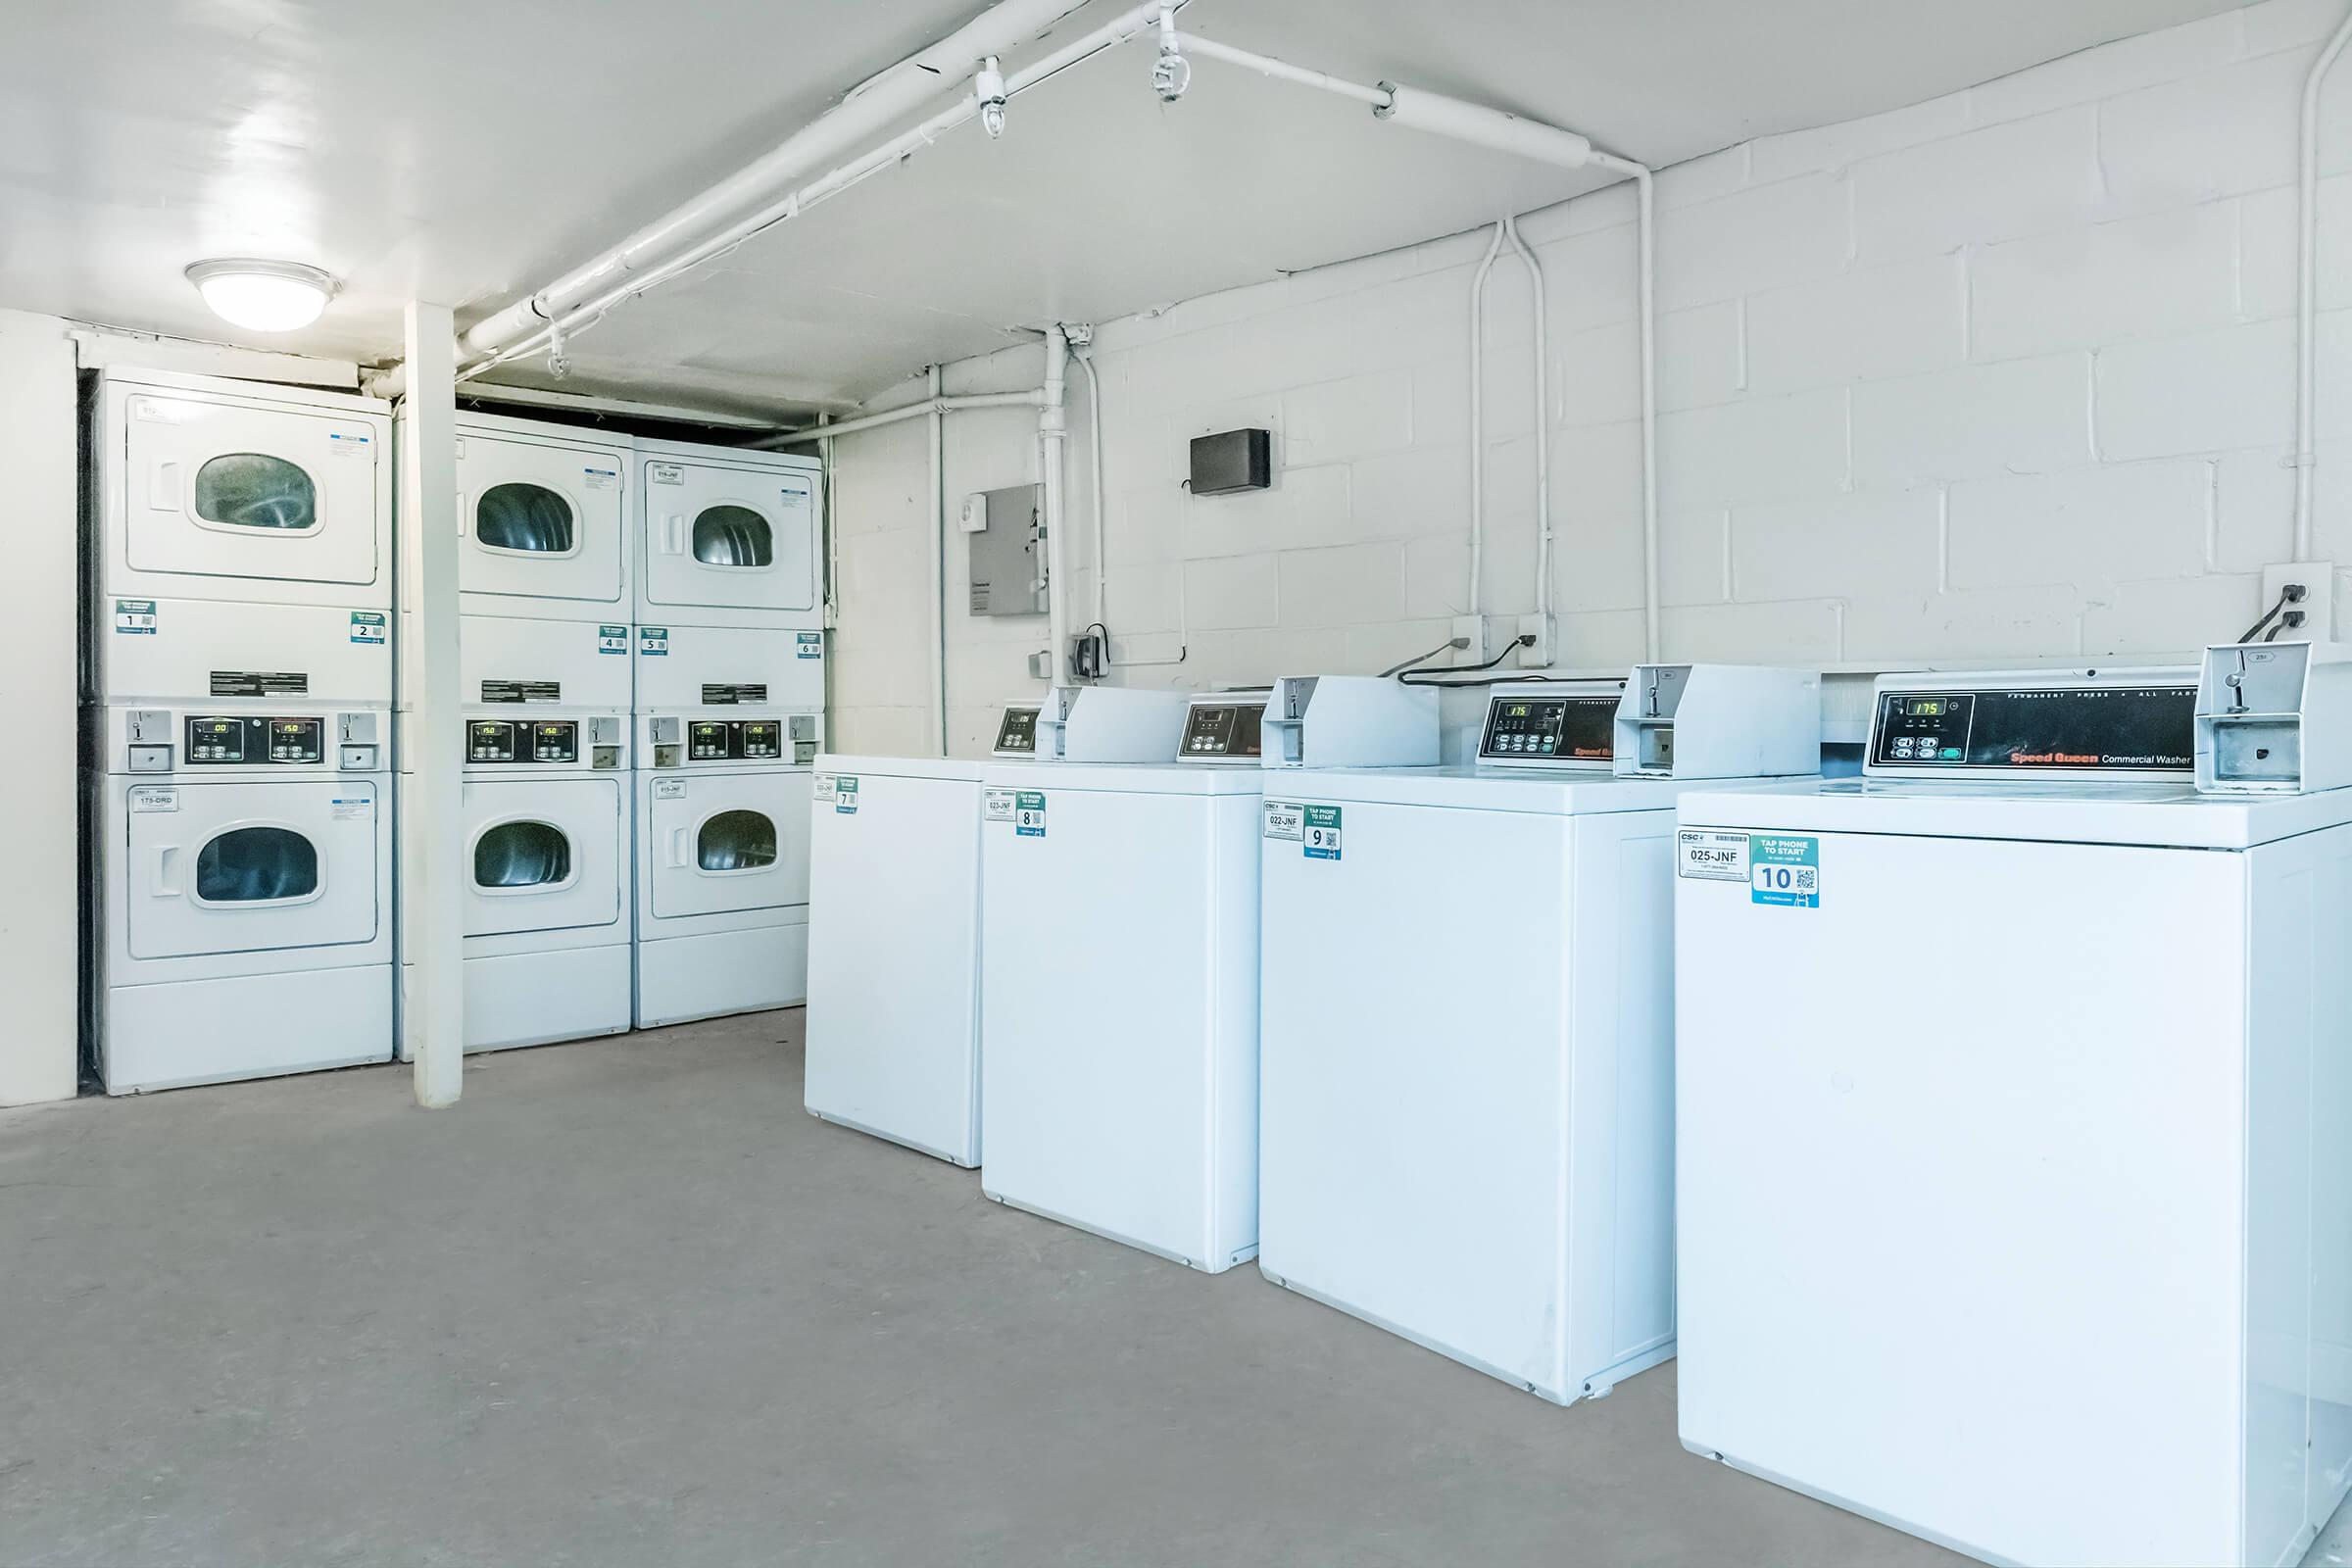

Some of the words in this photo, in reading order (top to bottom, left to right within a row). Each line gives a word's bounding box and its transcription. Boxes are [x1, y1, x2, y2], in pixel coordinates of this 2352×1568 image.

[126, 615, 133, 625] 1
[360, 626, 368, 635] 2
[648, 640, 654, 649] 5
[2010, 752, 2053, 764] Speed
[2054, 752, 2099, 763] Queen
[2102, 754, 2155, 764] Commercial
[2156, 755, 2192, 764] Washer
[841, 794, 847, 805] 7
[1023, 811, 1031, 825] 8
[1313, 829, 1322, 845] 9
[1778, 840, 1809, 849] PHONE
[1690, 850, 1738, 862] 025-JNF
[1762, 867, 1791, 889] 10
